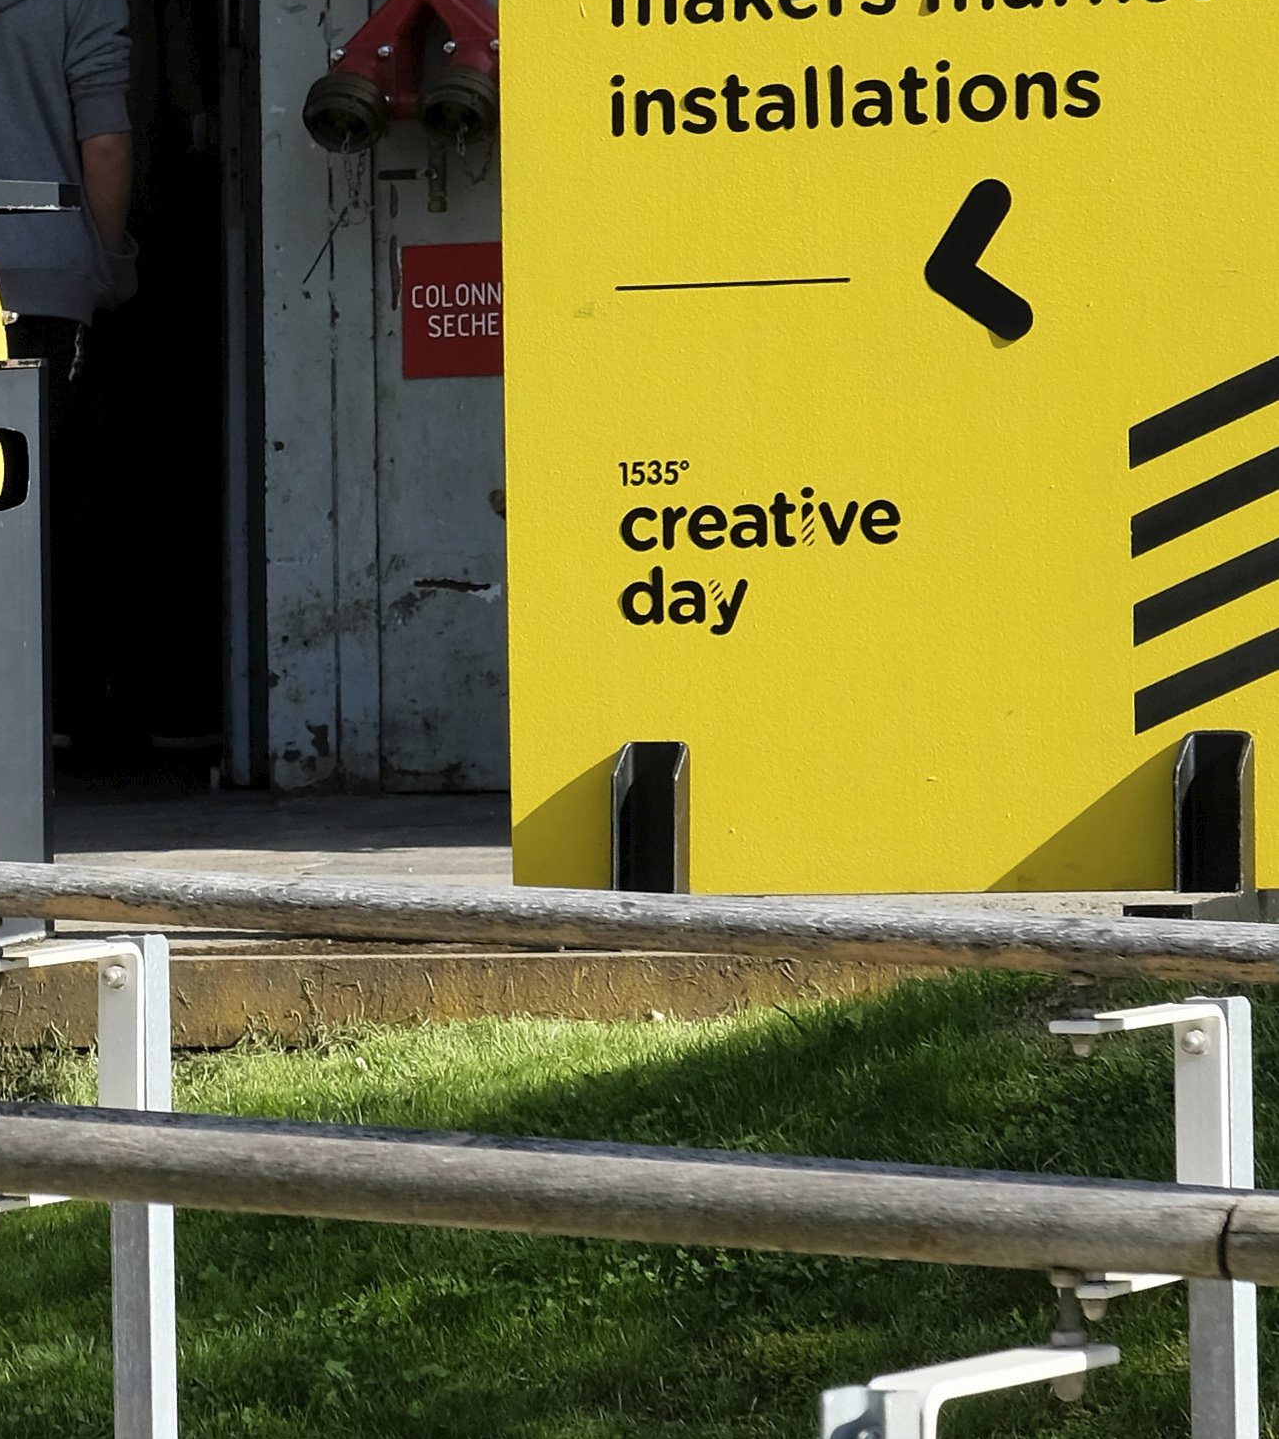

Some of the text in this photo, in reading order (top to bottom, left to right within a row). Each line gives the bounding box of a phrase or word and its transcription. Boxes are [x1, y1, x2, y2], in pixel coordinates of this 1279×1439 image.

[610, 59, 1102, 138] installations
[411, 282, 501, 309] COLONN
[427, 312, 500, 338] SECHE
[618, 460, 690, 487] 1535°
[619, 486, 901, 552] creative
[619, 565, 749, 636] day
